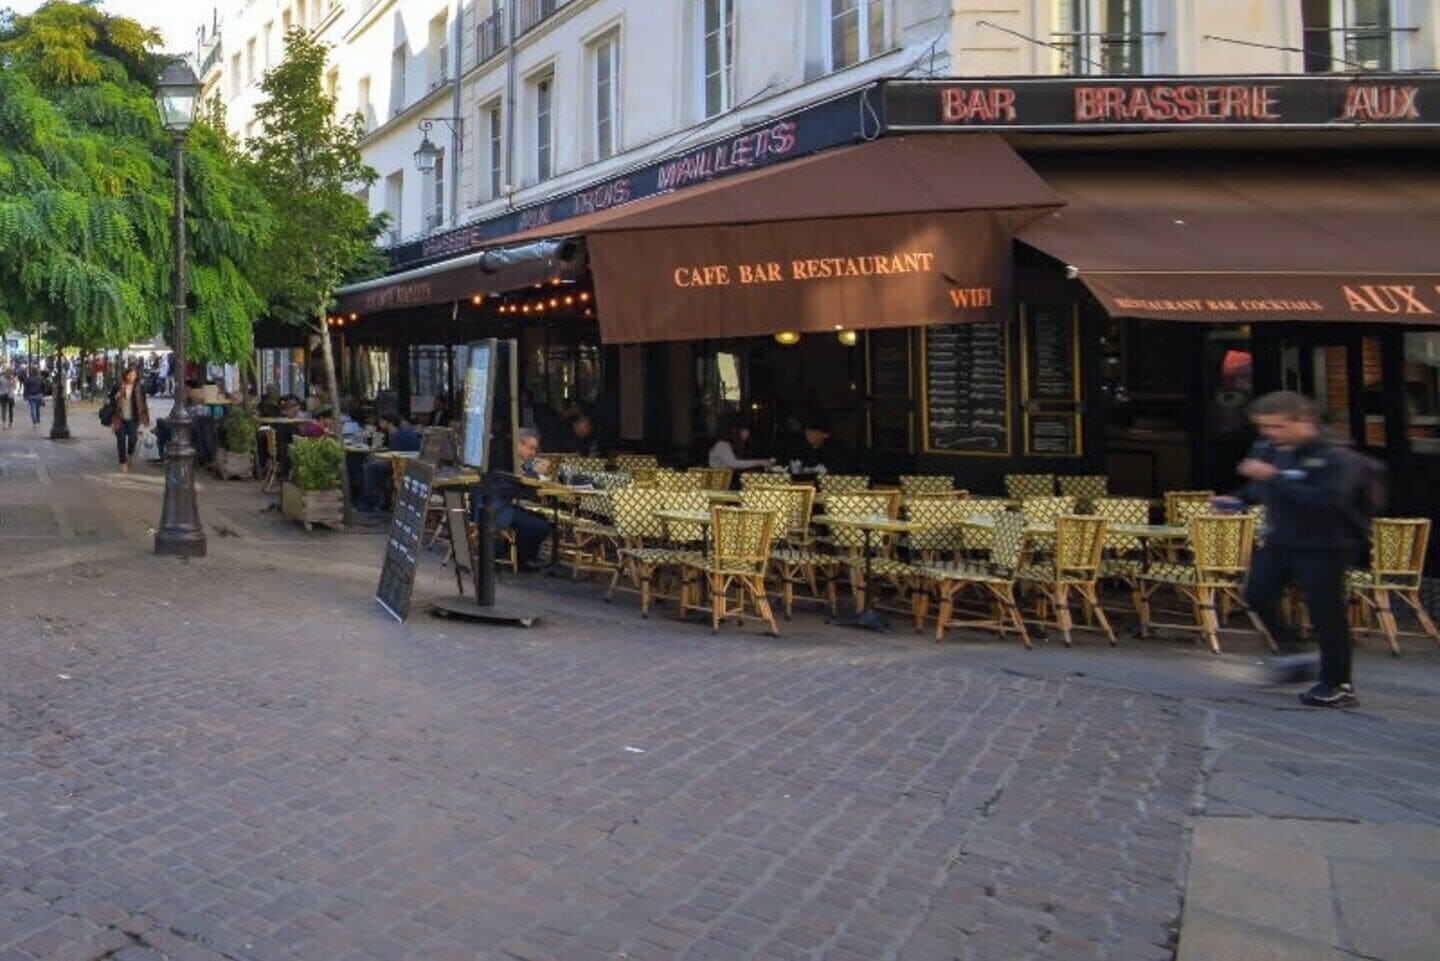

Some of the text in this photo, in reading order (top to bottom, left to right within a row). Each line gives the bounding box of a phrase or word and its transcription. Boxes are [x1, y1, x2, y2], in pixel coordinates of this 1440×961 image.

[940, 85, 1421, 122] BAR BRASSERIE AUX
[573, 180, 633, 214] TROIS
[658, 121, 799, 189] MAILLETS
[674, 252, 934, 288] CAFE BAR RESTAURANT
[949, 288, 992, 309] WIFI
[1114, 297, 1202, 312] RESTAURANT
[1206, 298, 1237, 312] BAR
[1341, 285, 1435, 315] AUX
